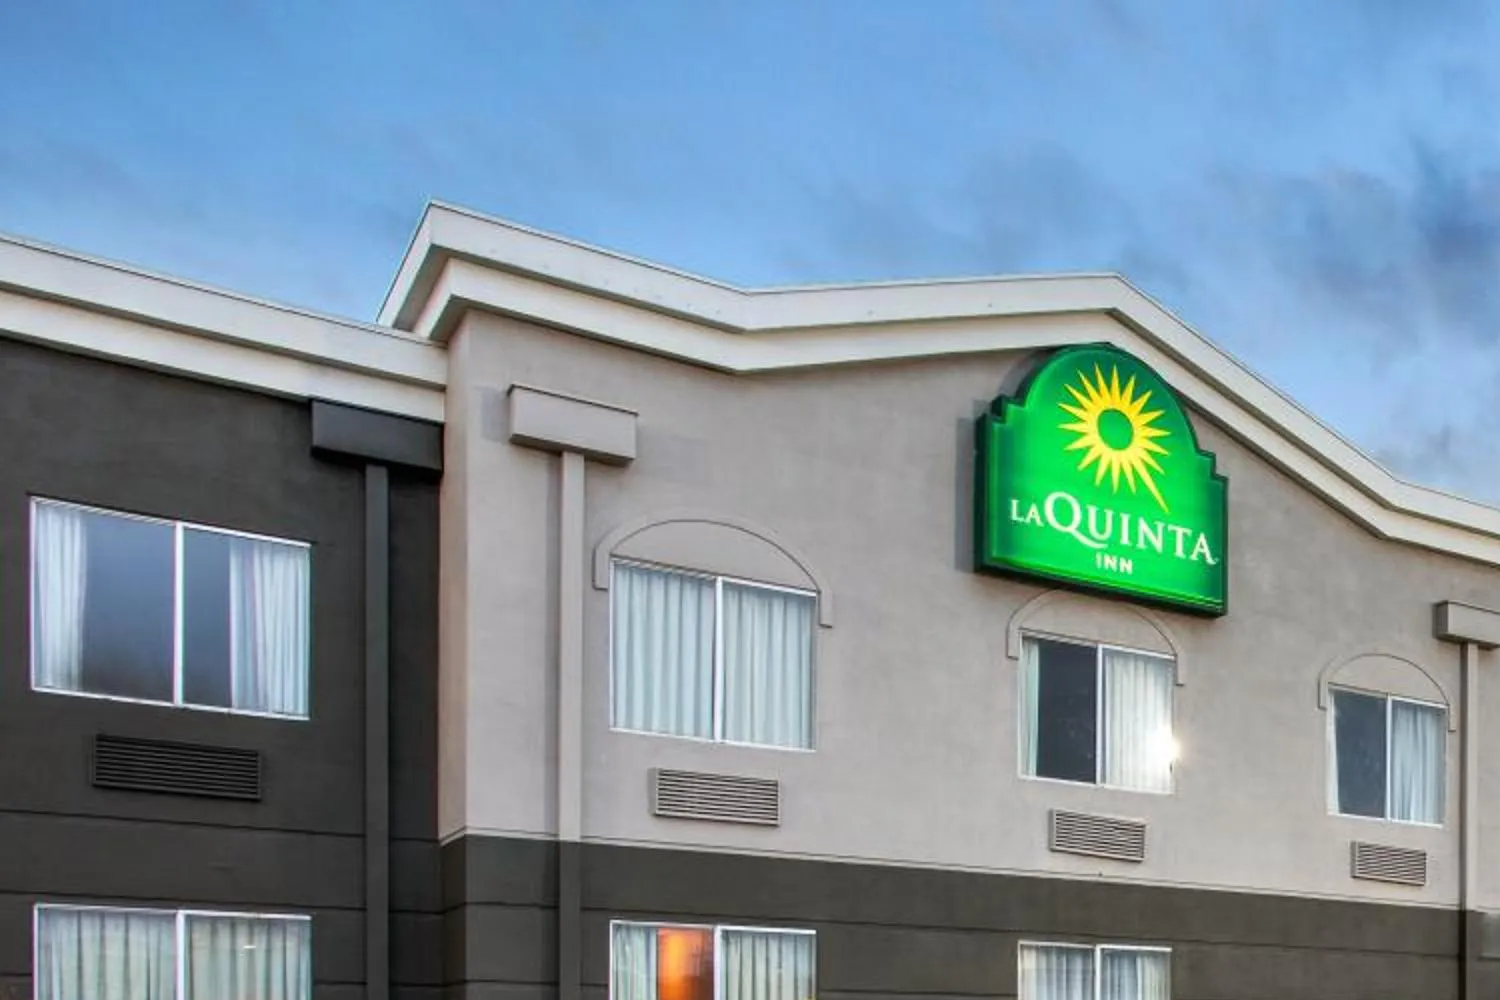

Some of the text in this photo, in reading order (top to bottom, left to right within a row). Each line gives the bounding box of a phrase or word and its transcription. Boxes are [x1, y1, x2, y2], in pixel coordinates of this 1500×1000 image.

[1011, 491, 1217, 565] LA QUINTA
[1096, 552, 1133, 575] INN
